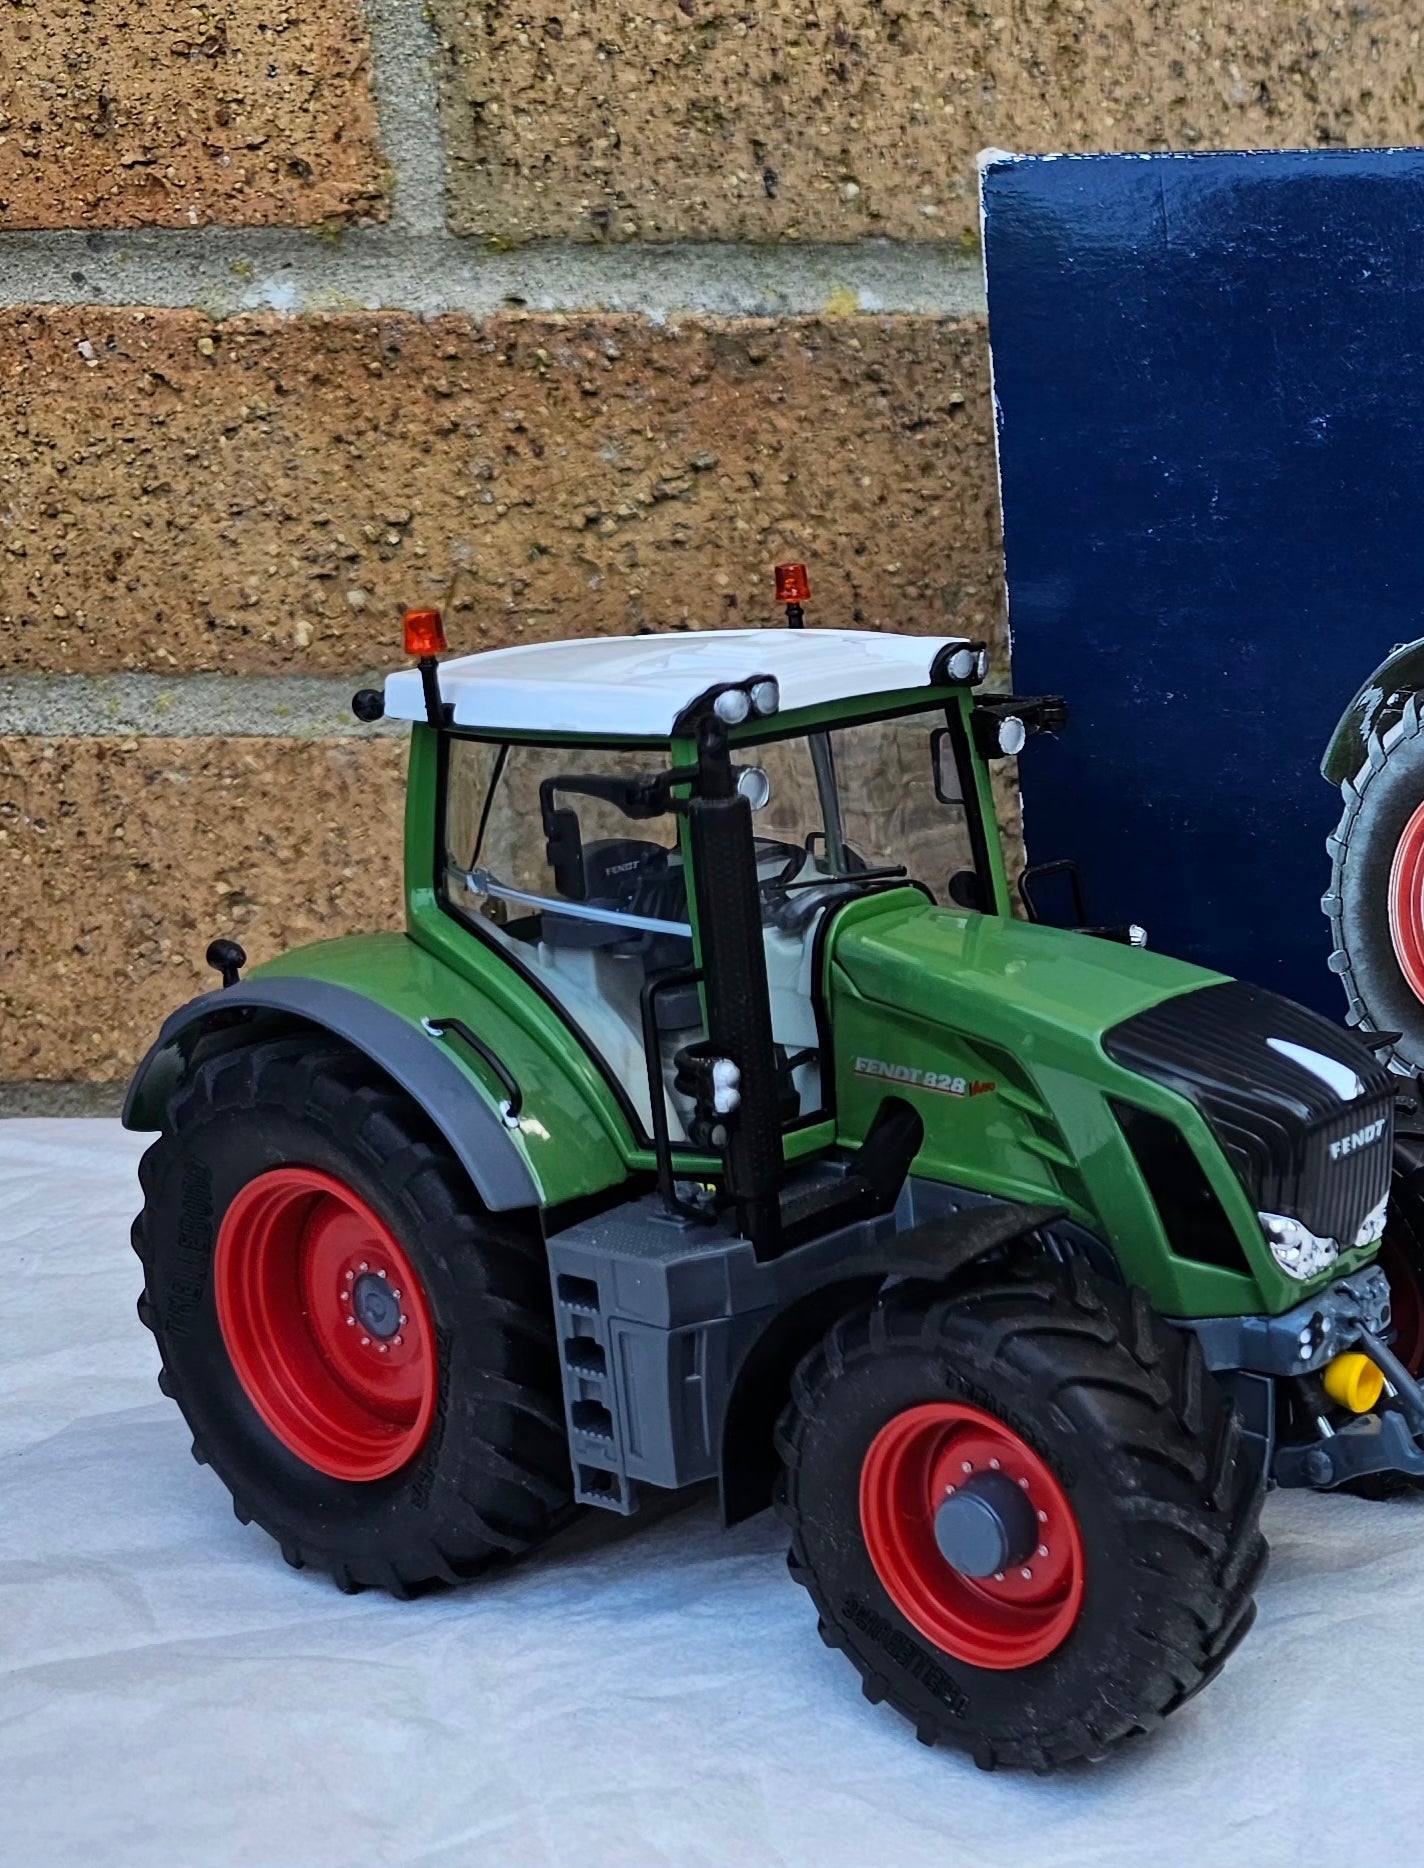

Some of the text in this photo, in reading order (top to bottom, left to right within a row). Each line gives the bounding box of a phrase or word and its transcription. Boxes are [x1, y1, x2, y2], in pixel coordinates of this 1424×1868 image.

[605, 861, 641, 876] FENDT
[854, 1056, 923, 1084] FENDT
[924, 1071, 967, 1094] 828
[1329, 1118, 1386, 1160] FENDT
